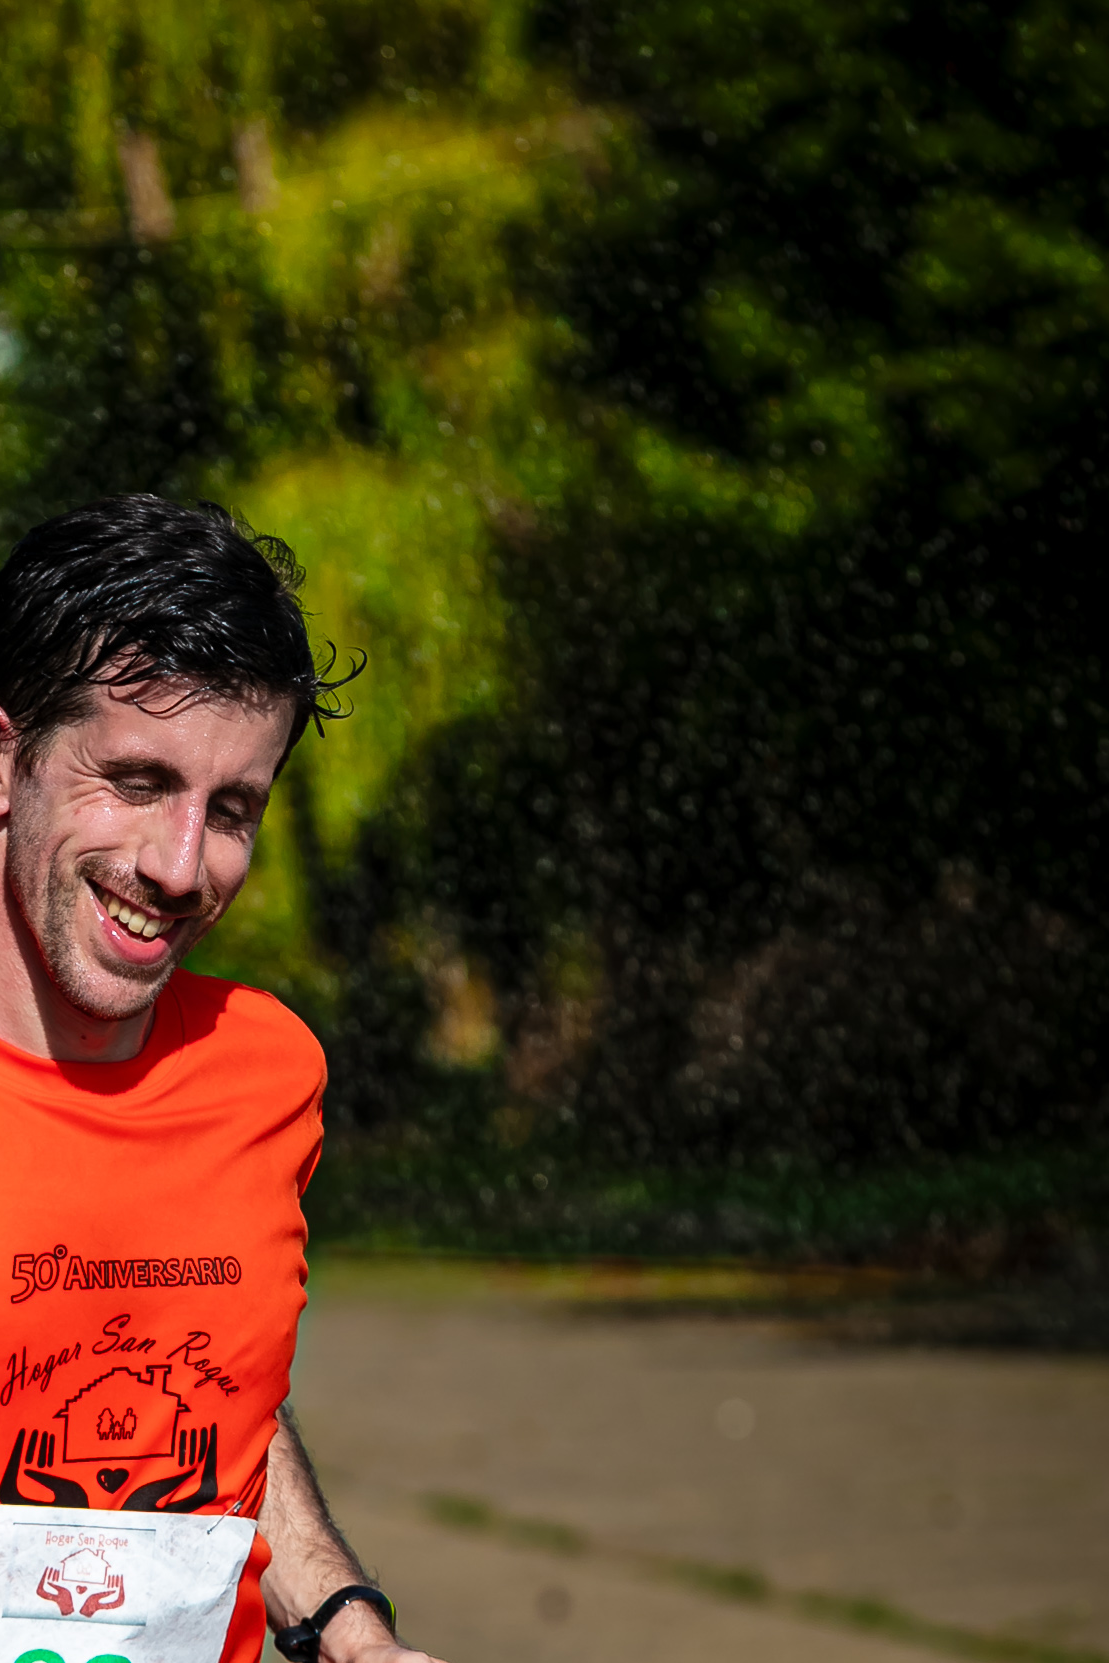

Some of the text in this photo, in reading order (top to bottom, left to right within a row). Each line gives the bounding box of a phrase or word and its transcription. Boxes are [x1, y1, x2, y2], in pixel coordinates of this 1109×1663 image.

[63, 1255, 242, 1290] ANIVERSARIO
[0, 1313, 240, 1406] Hogar San Roque
[45, 1530, 129, 1550] Hogar San Roque
